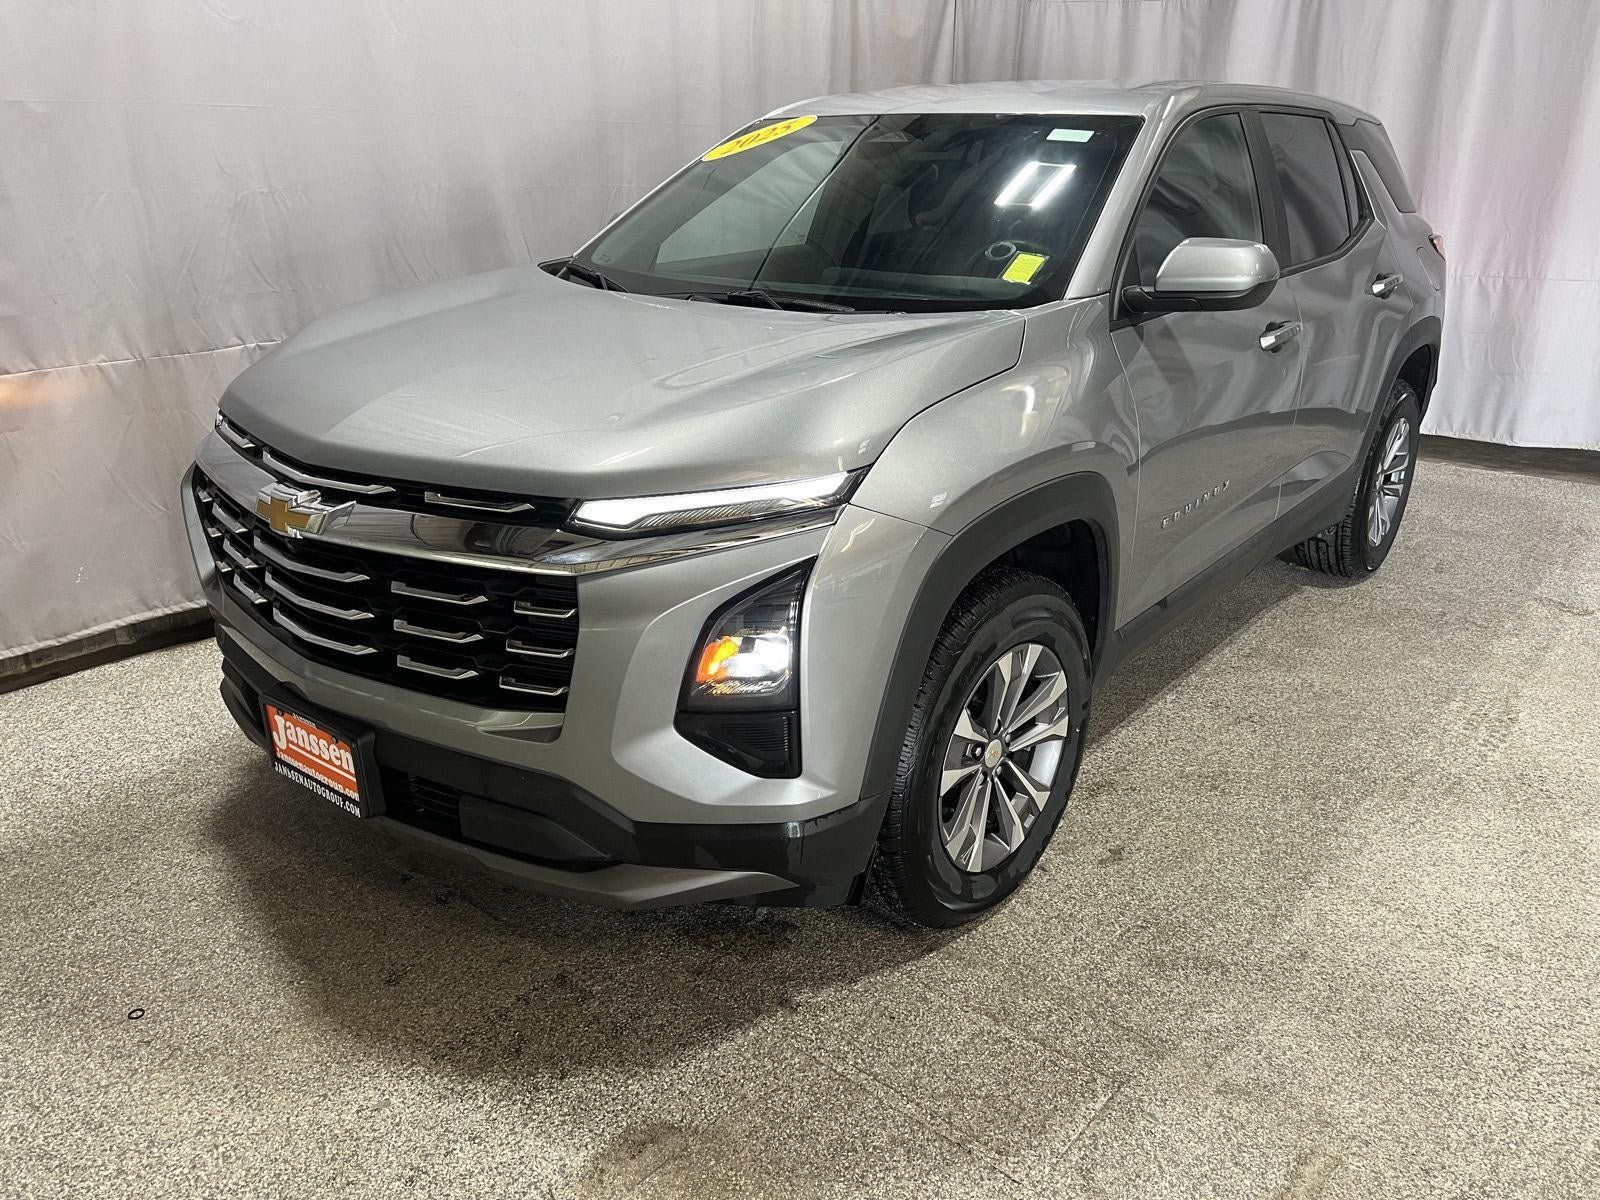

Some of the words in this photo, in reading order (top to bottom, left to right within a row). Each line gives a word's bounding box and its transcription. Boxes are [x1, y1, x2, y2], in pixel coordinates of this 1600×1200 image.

[717, 119, 801, 156] 2025
[1161, 479, 1230, 529] EQUINOX
[272, 713, 355, 774] Janssen
[274, 761, 361, 818] JANSSENAUTOGROUP.COM
